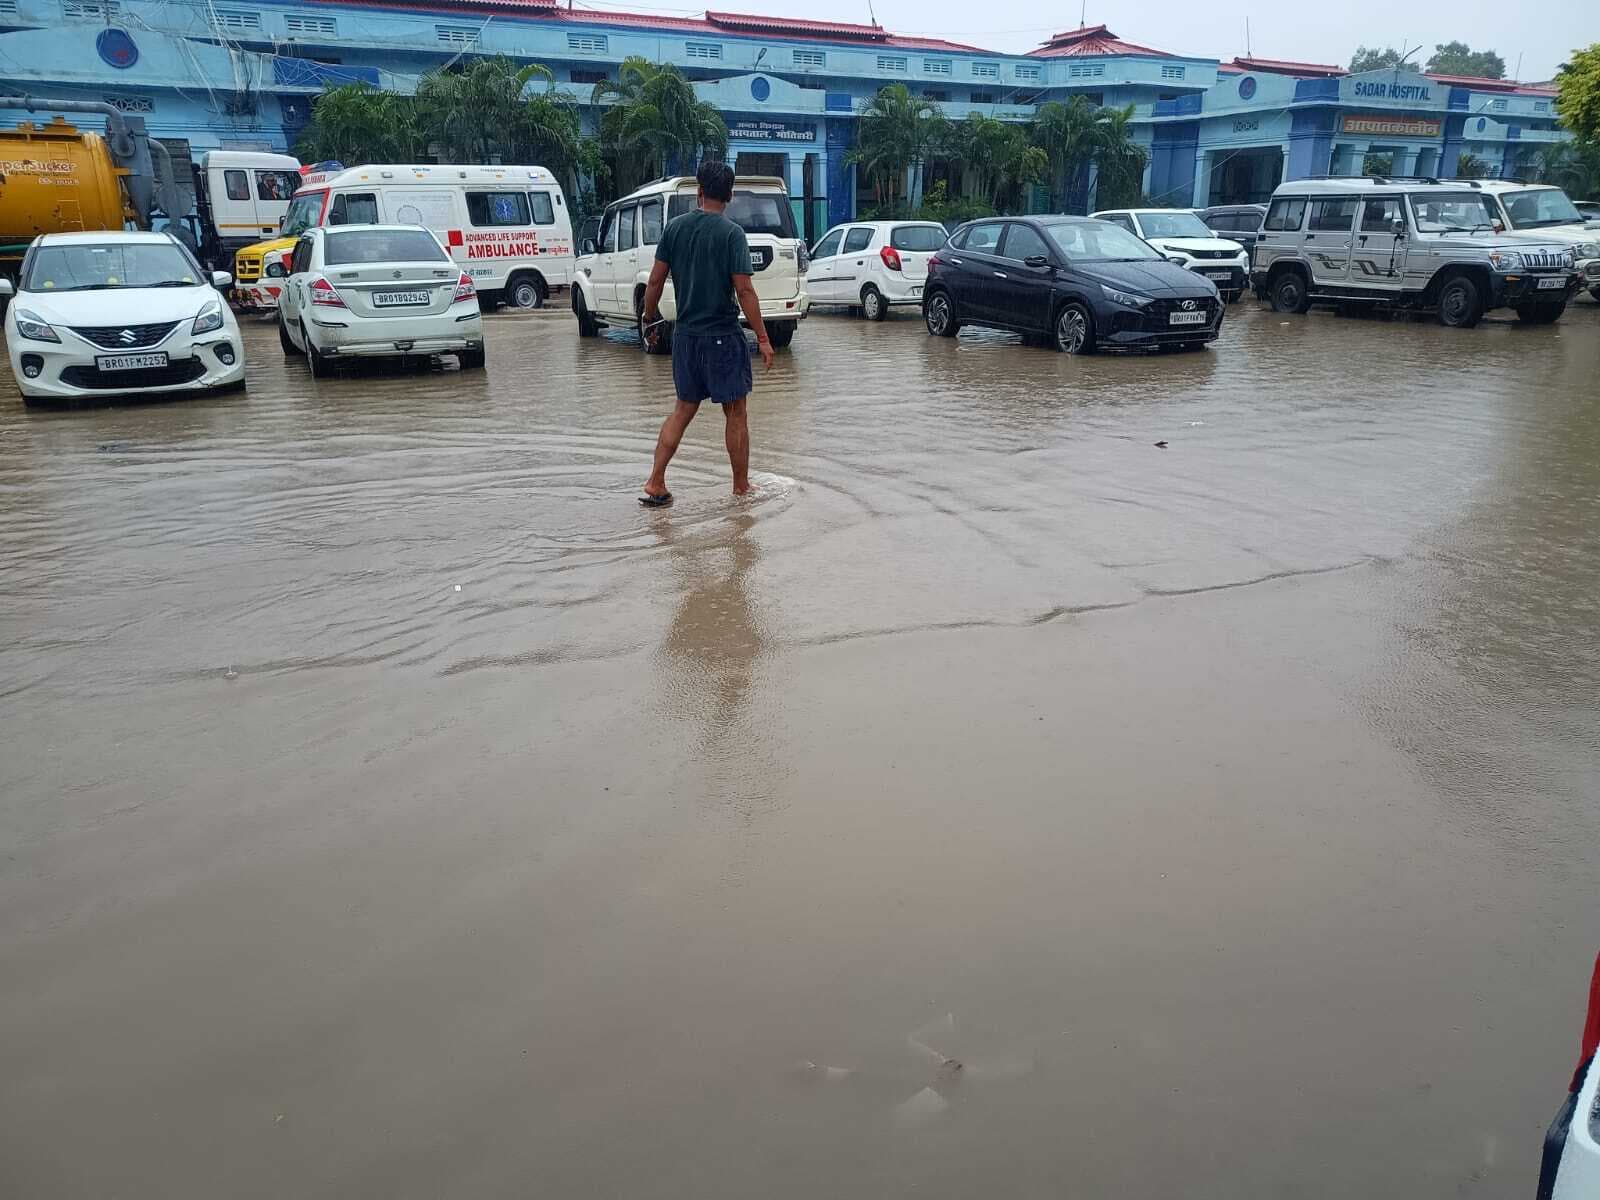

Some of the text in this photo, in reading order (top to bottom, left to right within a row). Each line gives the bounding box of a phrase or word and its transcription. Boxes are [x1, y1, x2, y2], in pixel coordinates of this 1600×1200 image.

[1355, 82, 1431, 100] SADAR HOSPITAL
[0, 159, 77, 176] perSucker
[465, 233, 497, 242] ADVANCED
[498, 232, 510, 241] LIFE
[511, 231, 537, 240] SUPPORT
[468, 243, 539, 258] AMBULANCE
[105, 355, 167, 369] BR01FM2252
